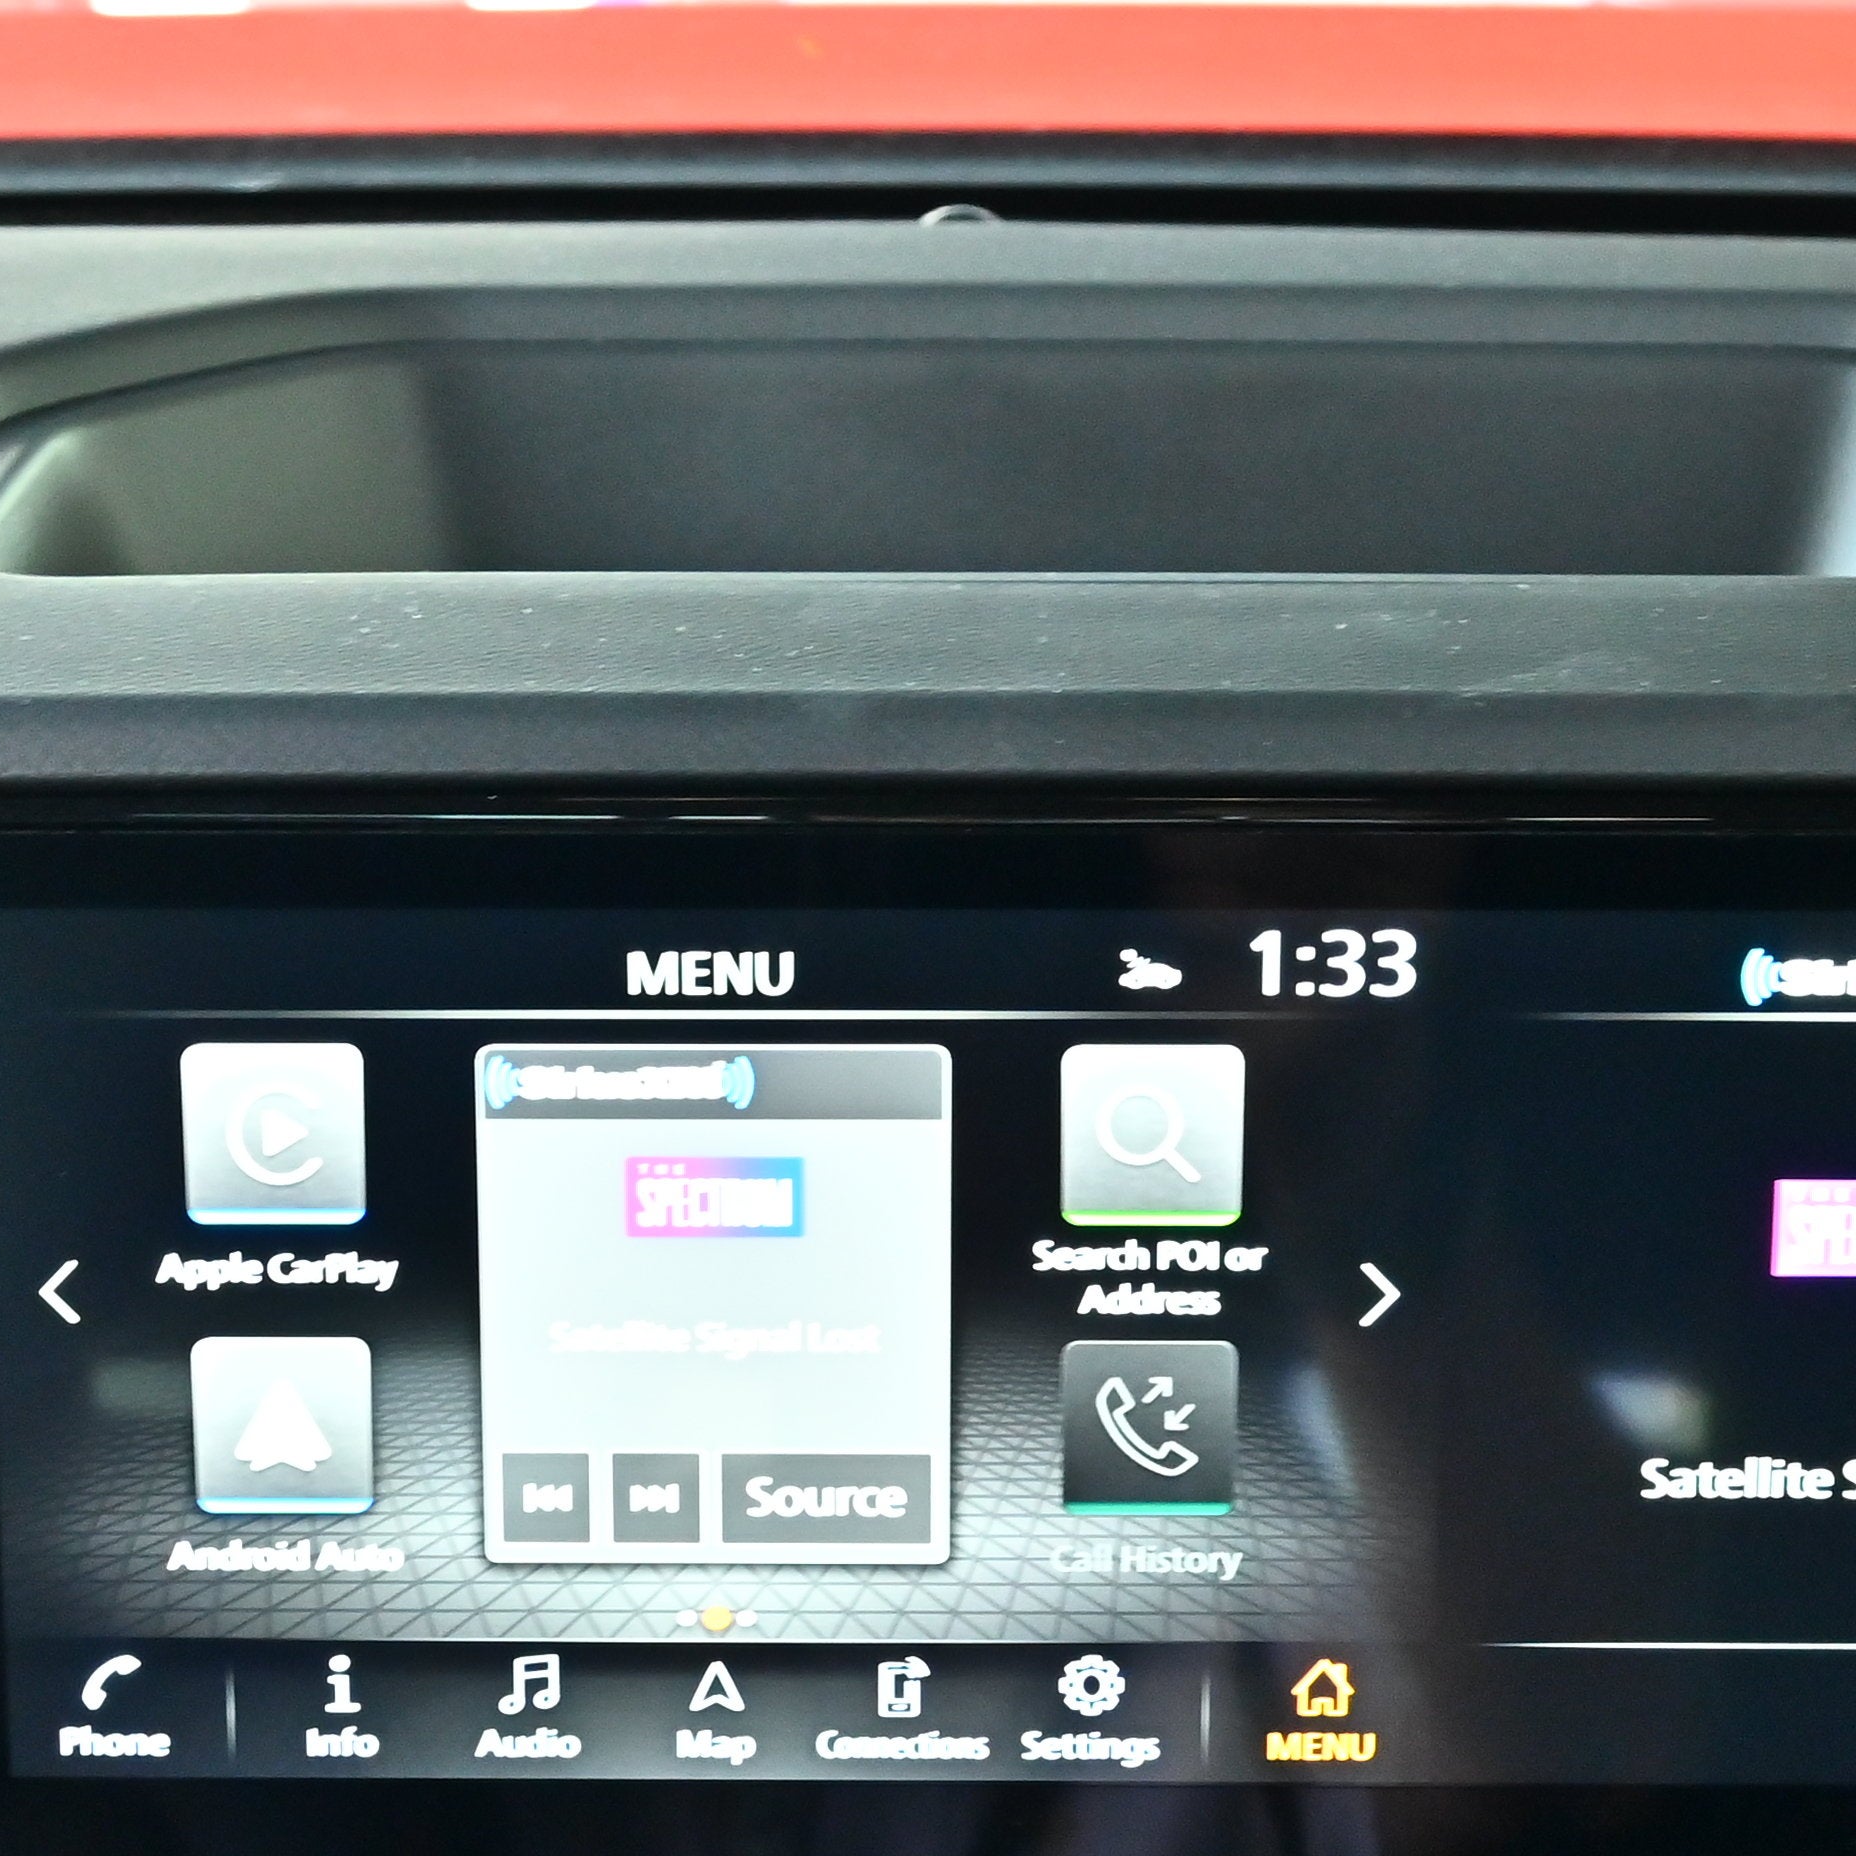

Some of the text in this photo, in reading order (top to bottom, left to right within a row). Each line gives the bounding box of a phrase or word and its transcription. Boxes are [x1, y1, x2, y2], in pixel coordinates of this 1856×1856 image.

[625, 950, 796, 998] MENU
[1248, 929, 1419, 999] 1:33
[155, 1251, 400, 1292] Apple CarPlay
[1031, 1240, 1269, 1273] Search POI or
[1077, 1283, 1222, 1318] Address
[1640, 1456, 1835, 1501] Satellite
[744, 1475, 909, 1520] Source
[166, 1539, 406, 1572] Android Auto
[1050, 1543, 1243, 1581] Call History
[58, 1726, 172, 1759] Phone
[305, 1725, 381, 1759] Info
[474, 1726, 582, 1760] Audio
[676, 1730, 757, 1766] Map
[815, 1730, 991, 1762] Connections
[1020, 1730, 1161, 1768] Settings
[1265, 1731, 1376, 1763] MENU
